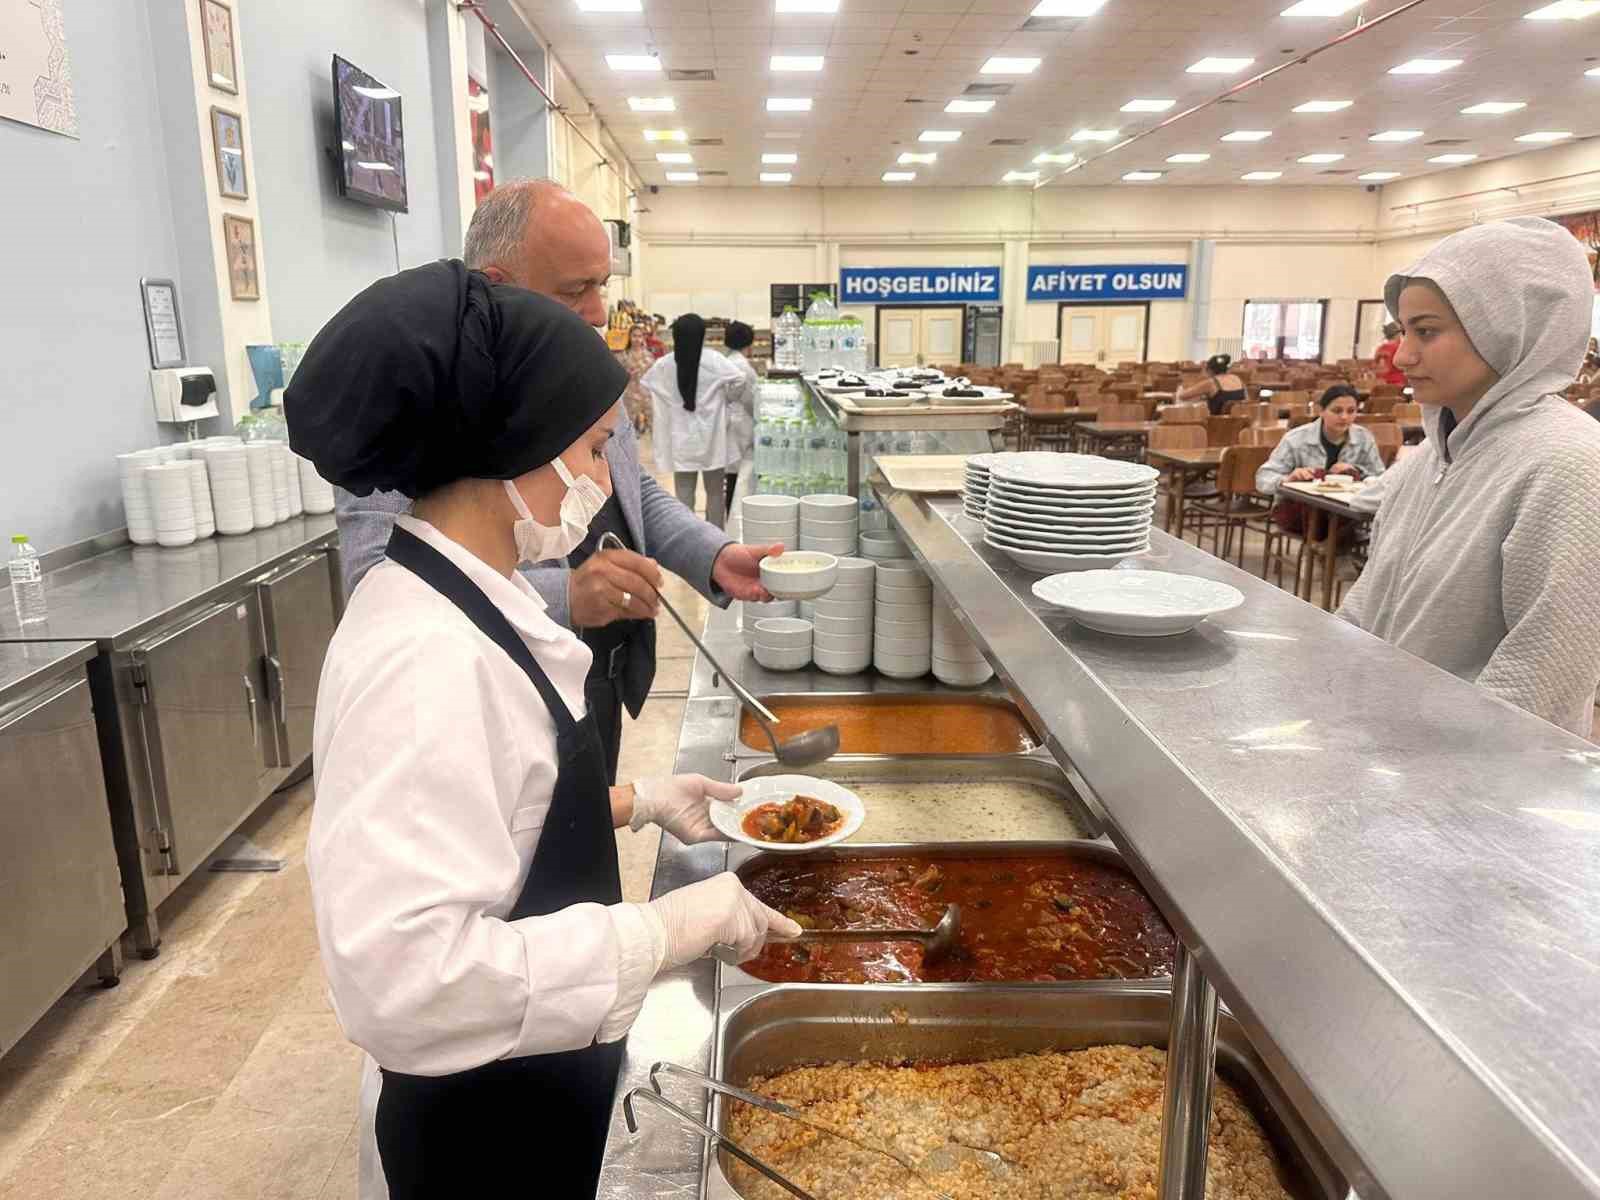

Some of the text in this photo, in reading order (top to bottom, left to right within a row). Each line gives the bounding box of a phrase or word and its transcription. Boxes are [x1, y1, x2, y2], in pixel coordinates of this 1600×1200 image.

[846, 271, 995, 296] HOŞGELDİNİZ
[1032, 270, 1182, 291] AFİYET OLSUN
